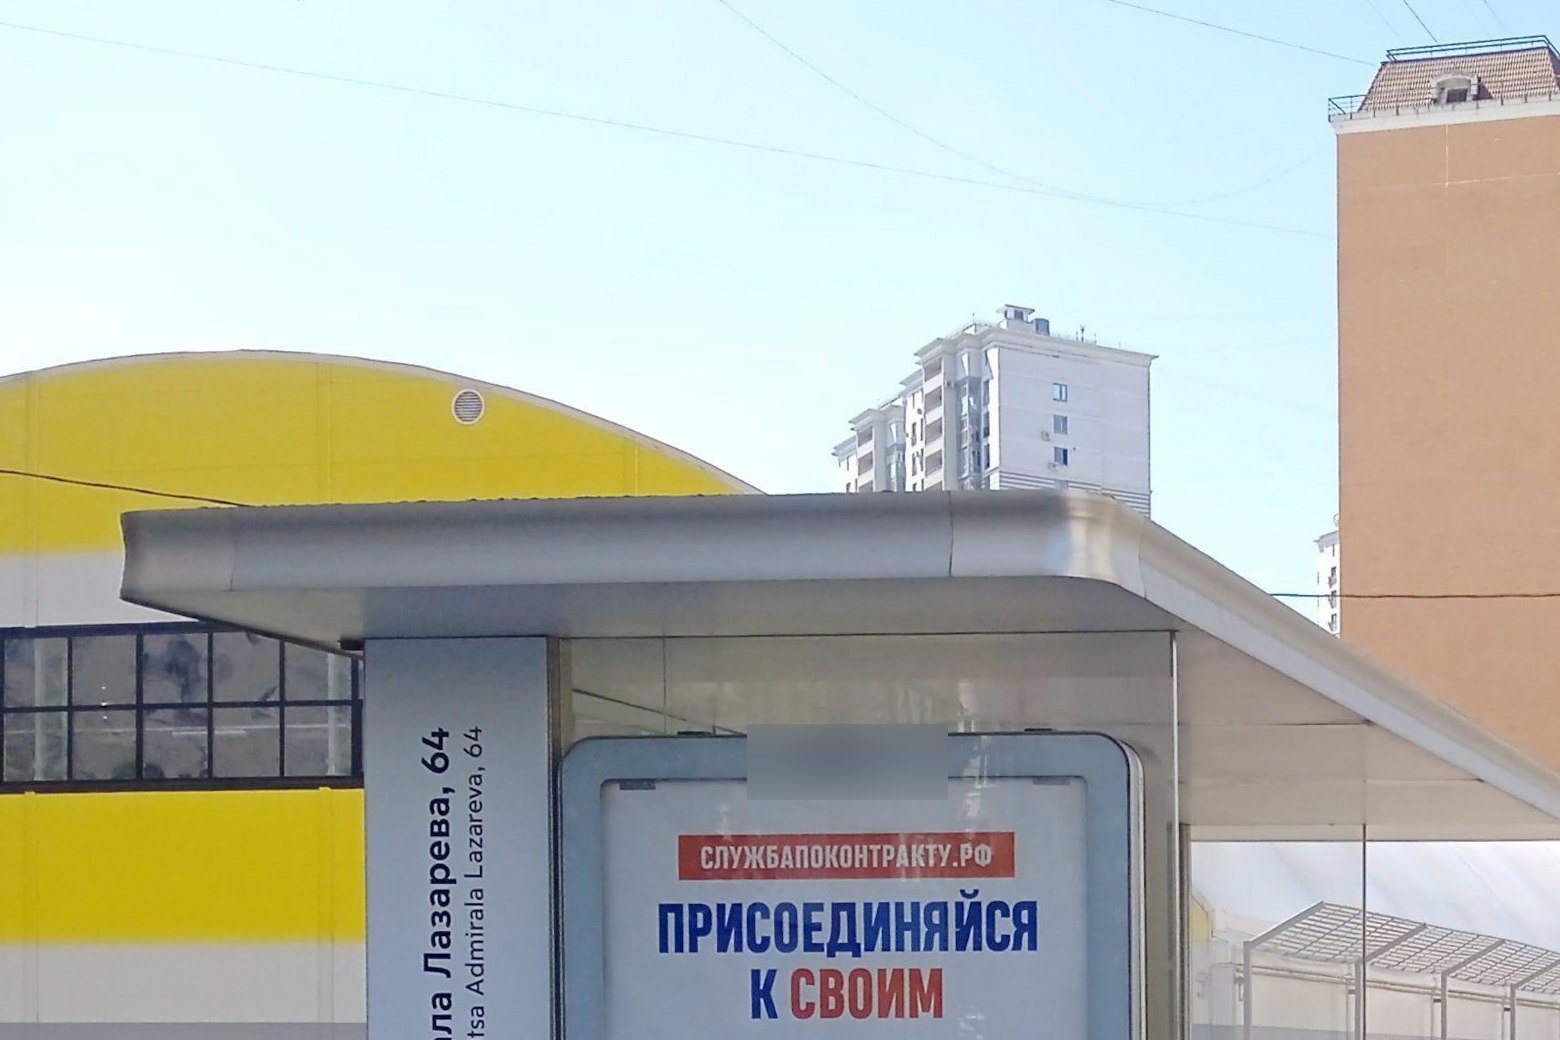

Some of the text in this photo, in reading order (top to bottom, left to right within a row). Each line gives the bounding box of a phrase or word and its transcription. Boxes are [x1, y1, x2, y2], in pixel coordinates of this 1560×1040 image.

[421, 727, 450, 774] 64
[463, 726, 483, 757] 64
[463, 766, 486, 878] Lazareva,
[422, 786, 457, 979] Лазарева,
[699, 841, 994, 872] СЛУЖБАПОКОНТРАКТУ.РФ
[464, 888, 485, 996] Admirala
[657, 888, 1039, 958] ПРИСОЕДИНЯЙСЯ
[750, 967, 944, 1020] К СВОИМ
